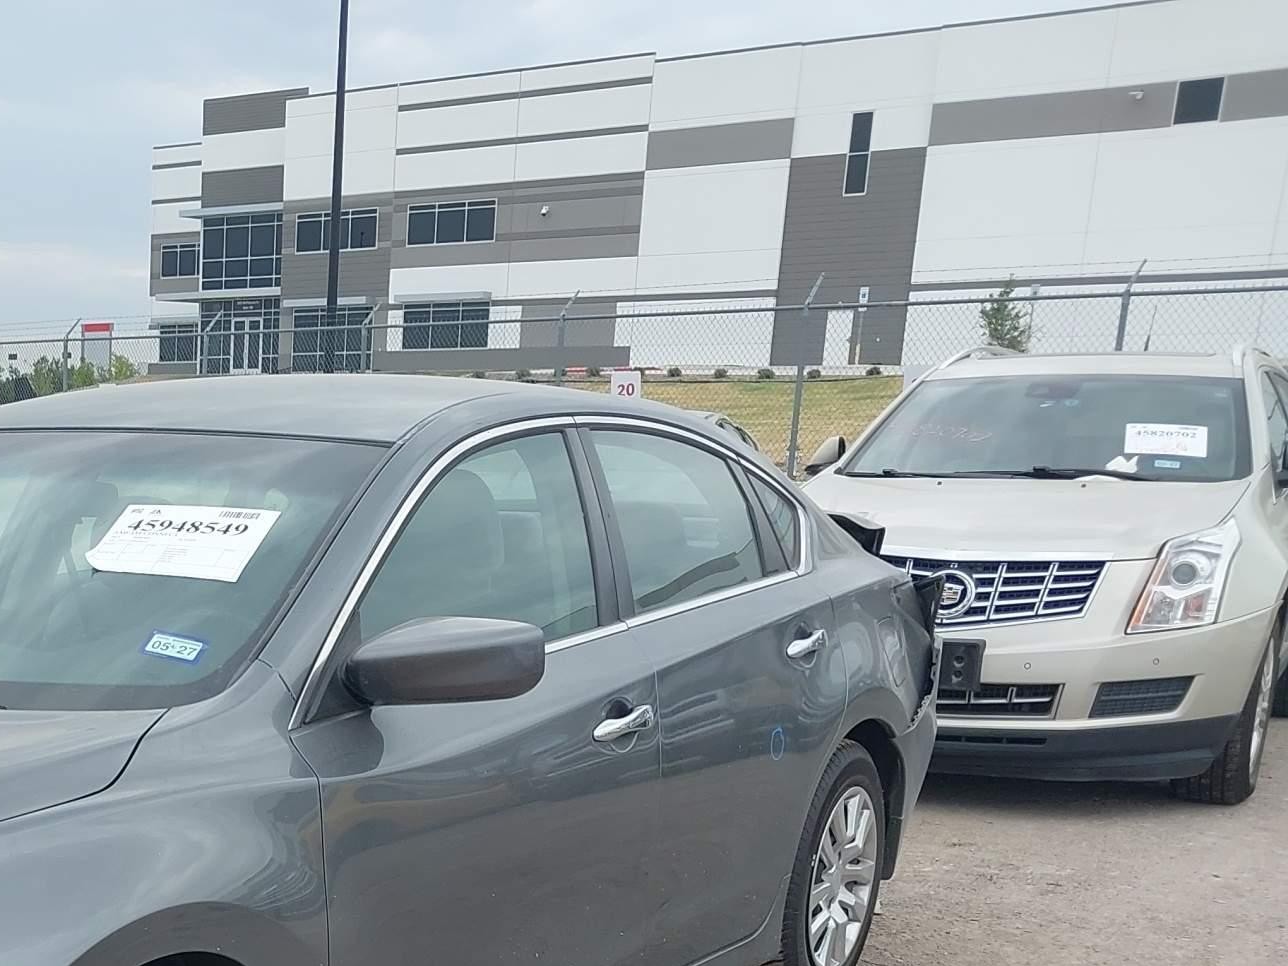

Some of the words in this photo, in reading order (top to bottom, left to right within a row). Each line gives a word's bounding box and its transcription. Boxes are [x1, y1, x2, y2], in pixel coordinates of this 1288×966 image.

[616, 382, 635, 397] 20
[127, 519, 249, 537] 45948549
[151, 640, 172, 651] 05
[176, 645, 198, 656] 27
